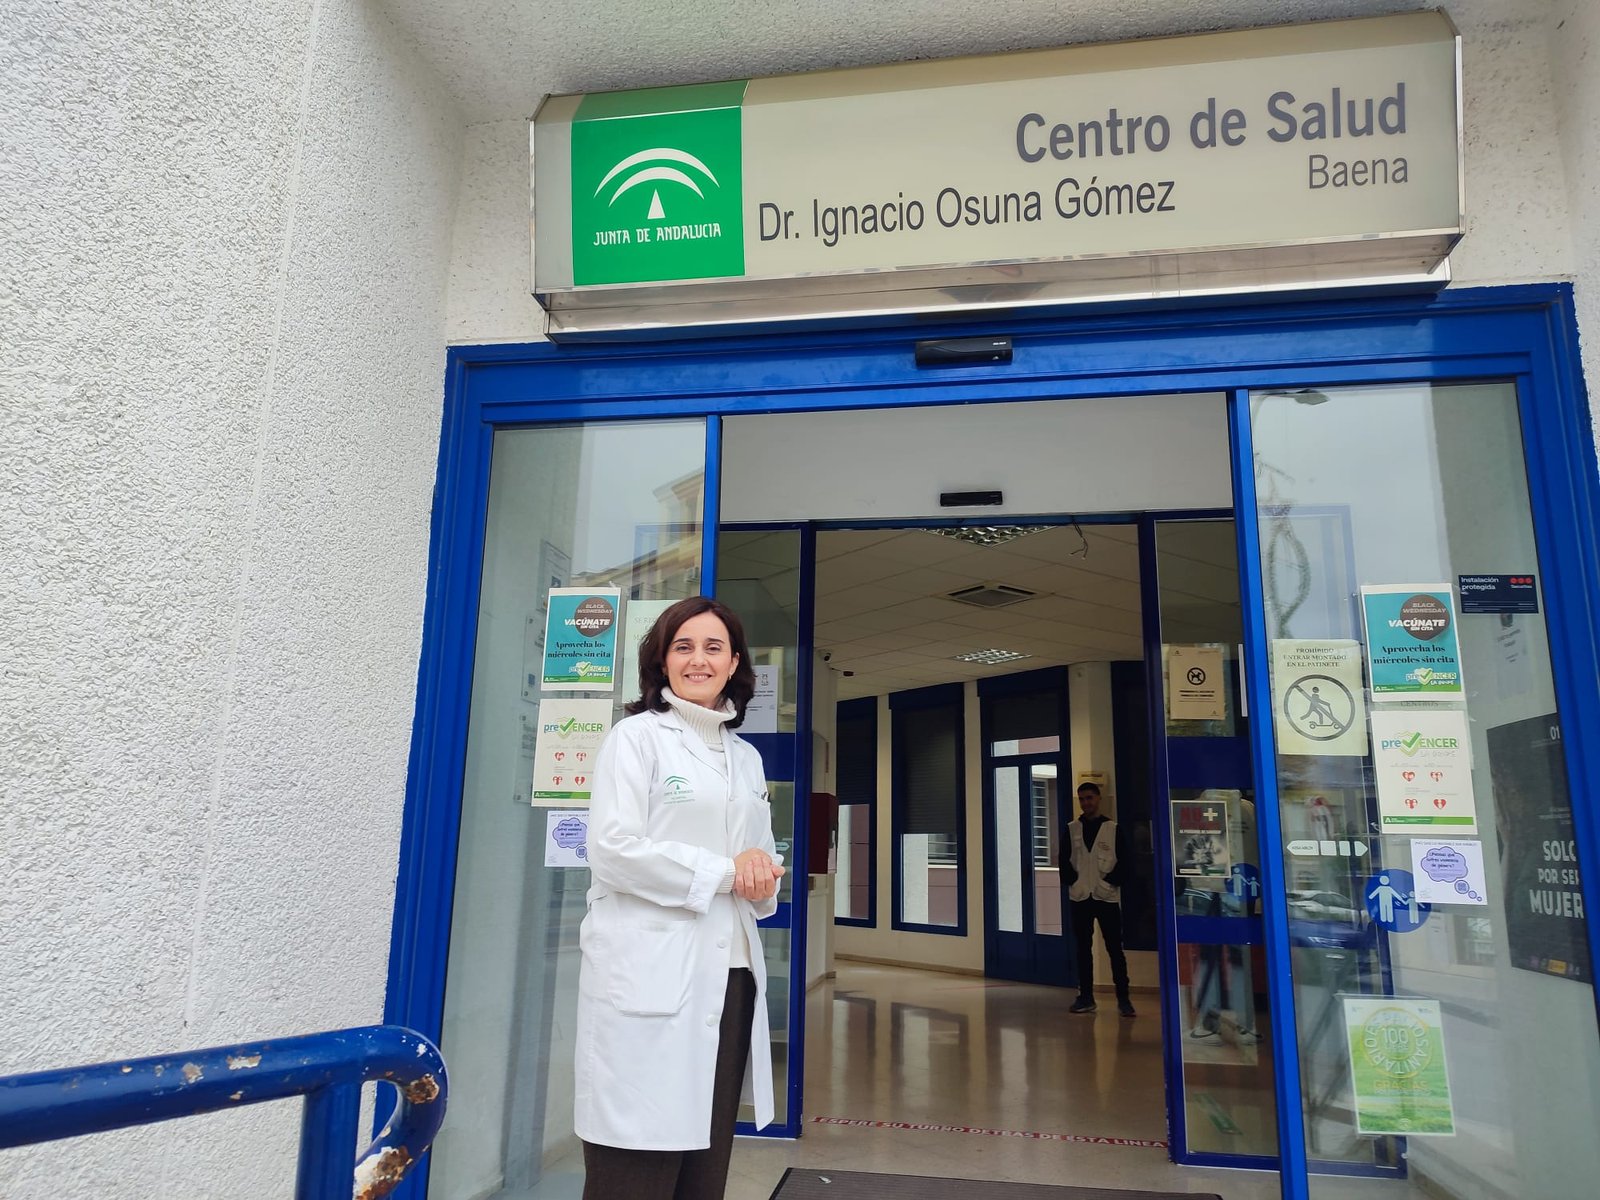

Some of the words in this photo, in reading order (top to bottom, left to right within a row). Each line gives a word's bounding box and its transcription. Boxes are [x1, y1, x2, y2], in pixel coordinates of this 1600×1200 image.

[1016, 108, 1171, 163] Centro
[1189, 97, 1247, 149] de
[1266, 82, 1407, 143] Salud
[1308, 154, 1409, 189] Baena
[758, 202, 800, 241] Dr.
[813, 192, 925, 247] Ignacio
[936, 187, 1042, 227] Osuna
[1054, 176, 1176, 219] Gómez
[593, 229, 631, 246] JUNTA
[636, 228, 651, 243] DE
[656, 222, 722, 241] ANDALUCIA
[564, 617, 611, 626] VACÚNATE
[1388, 618, 1446, 627] VACÚNATE
[555, 641, 593, 649] Aprovecha
[1382, 645, 1430, 654] Aprovecha
[596, 650, 611, 658] cita
[1373, 656, 1420, 665] miércoles
[1538, 868, 1559, 884] POR
[1529, 889, 1584, 919] MUJER
